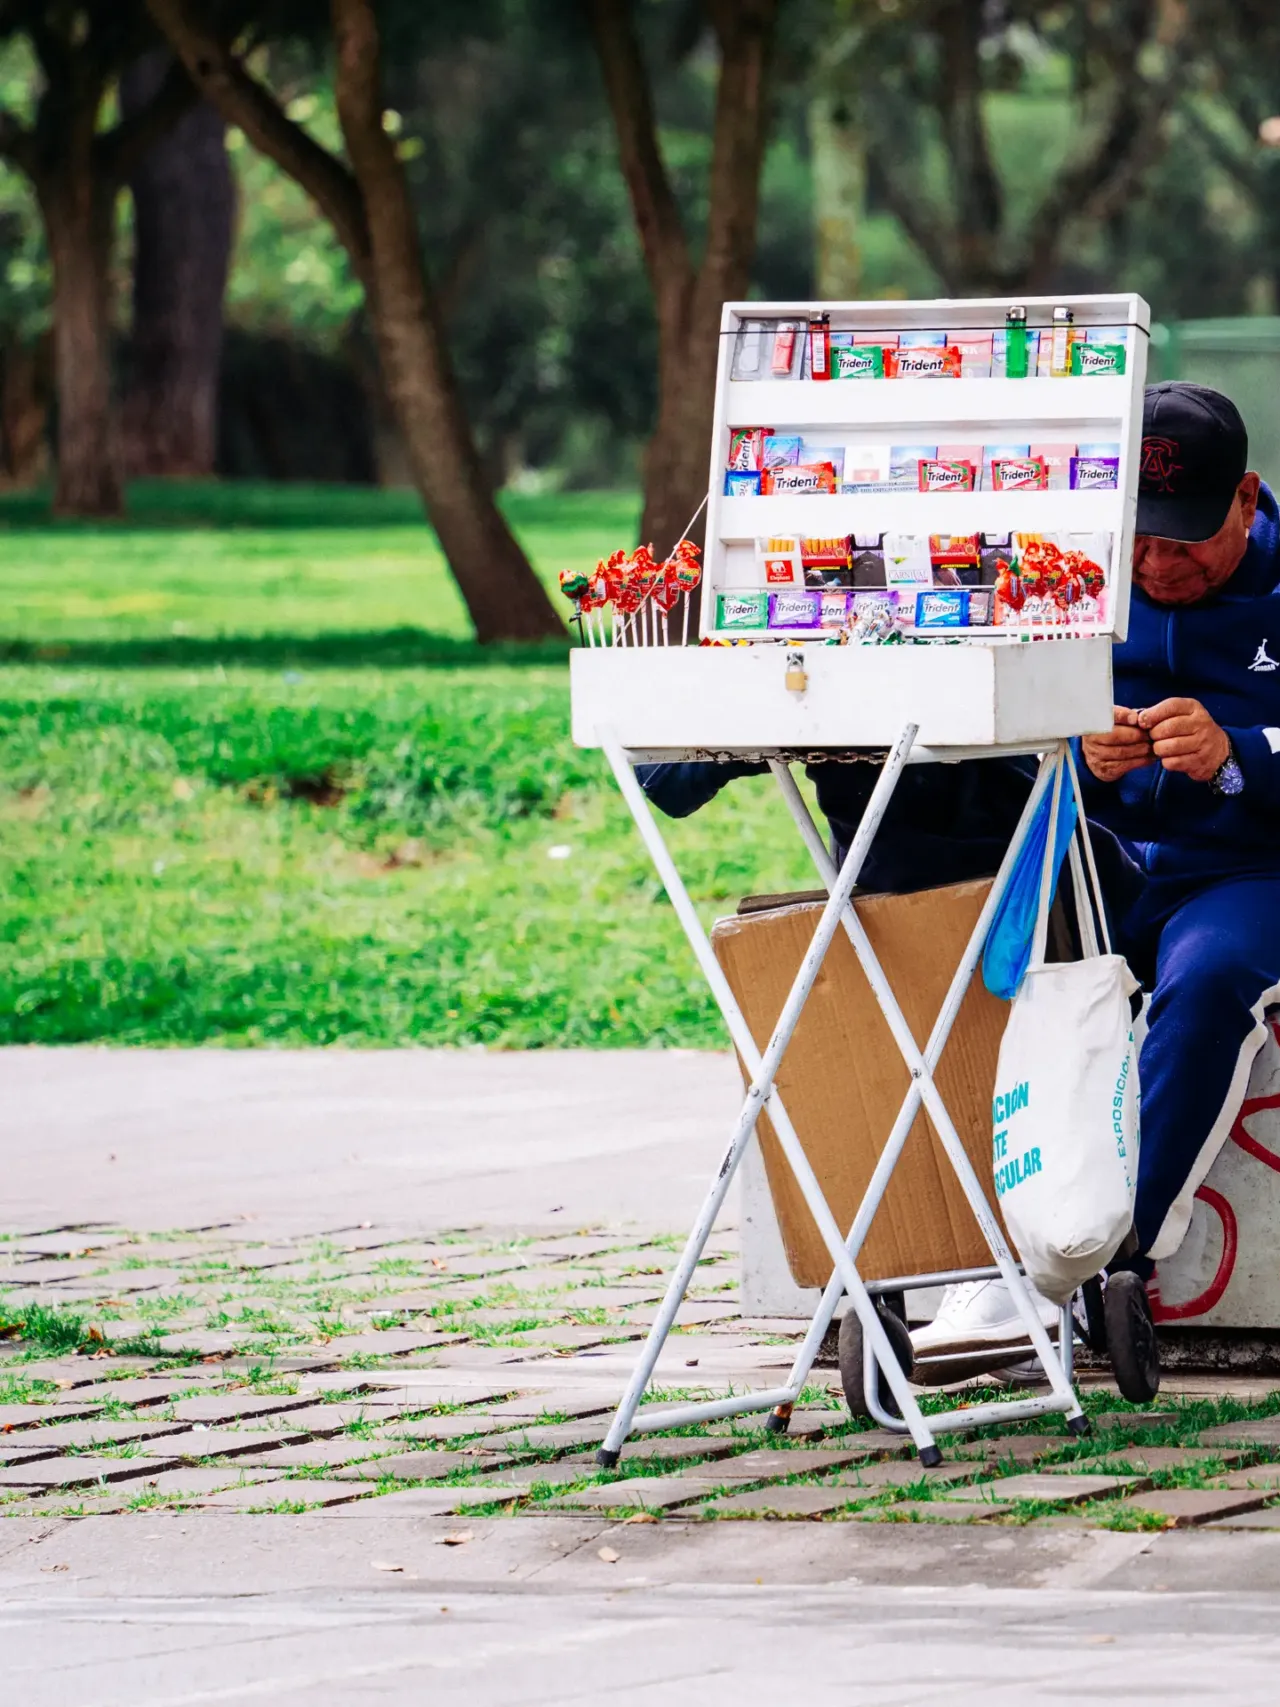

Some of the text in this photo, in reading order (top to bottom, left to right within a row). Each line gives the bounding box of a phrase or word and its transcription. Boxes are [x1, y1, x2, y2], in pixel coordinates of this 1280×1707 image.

[838, 359, 873, 368] Trident
[900, 359, 943, 371] Trident
[1080, 356, 1115, 366] Trident
[740, 440, 751, 471] ident
[927, 471, 962, 482] Trident
[1000, 469, 1034, 480] Trident
[1079, 469, 1114, 479] Trident
[775, 475, 818, 489] Trident
[725, 604, 758, 614] Trident
[777, 602, 812, 612] Trident
[924, 603, 959, 613] Trident
[992, 1080, 1029, 1126] CIÓN
[993, 1130, 1008, 1163] TE
